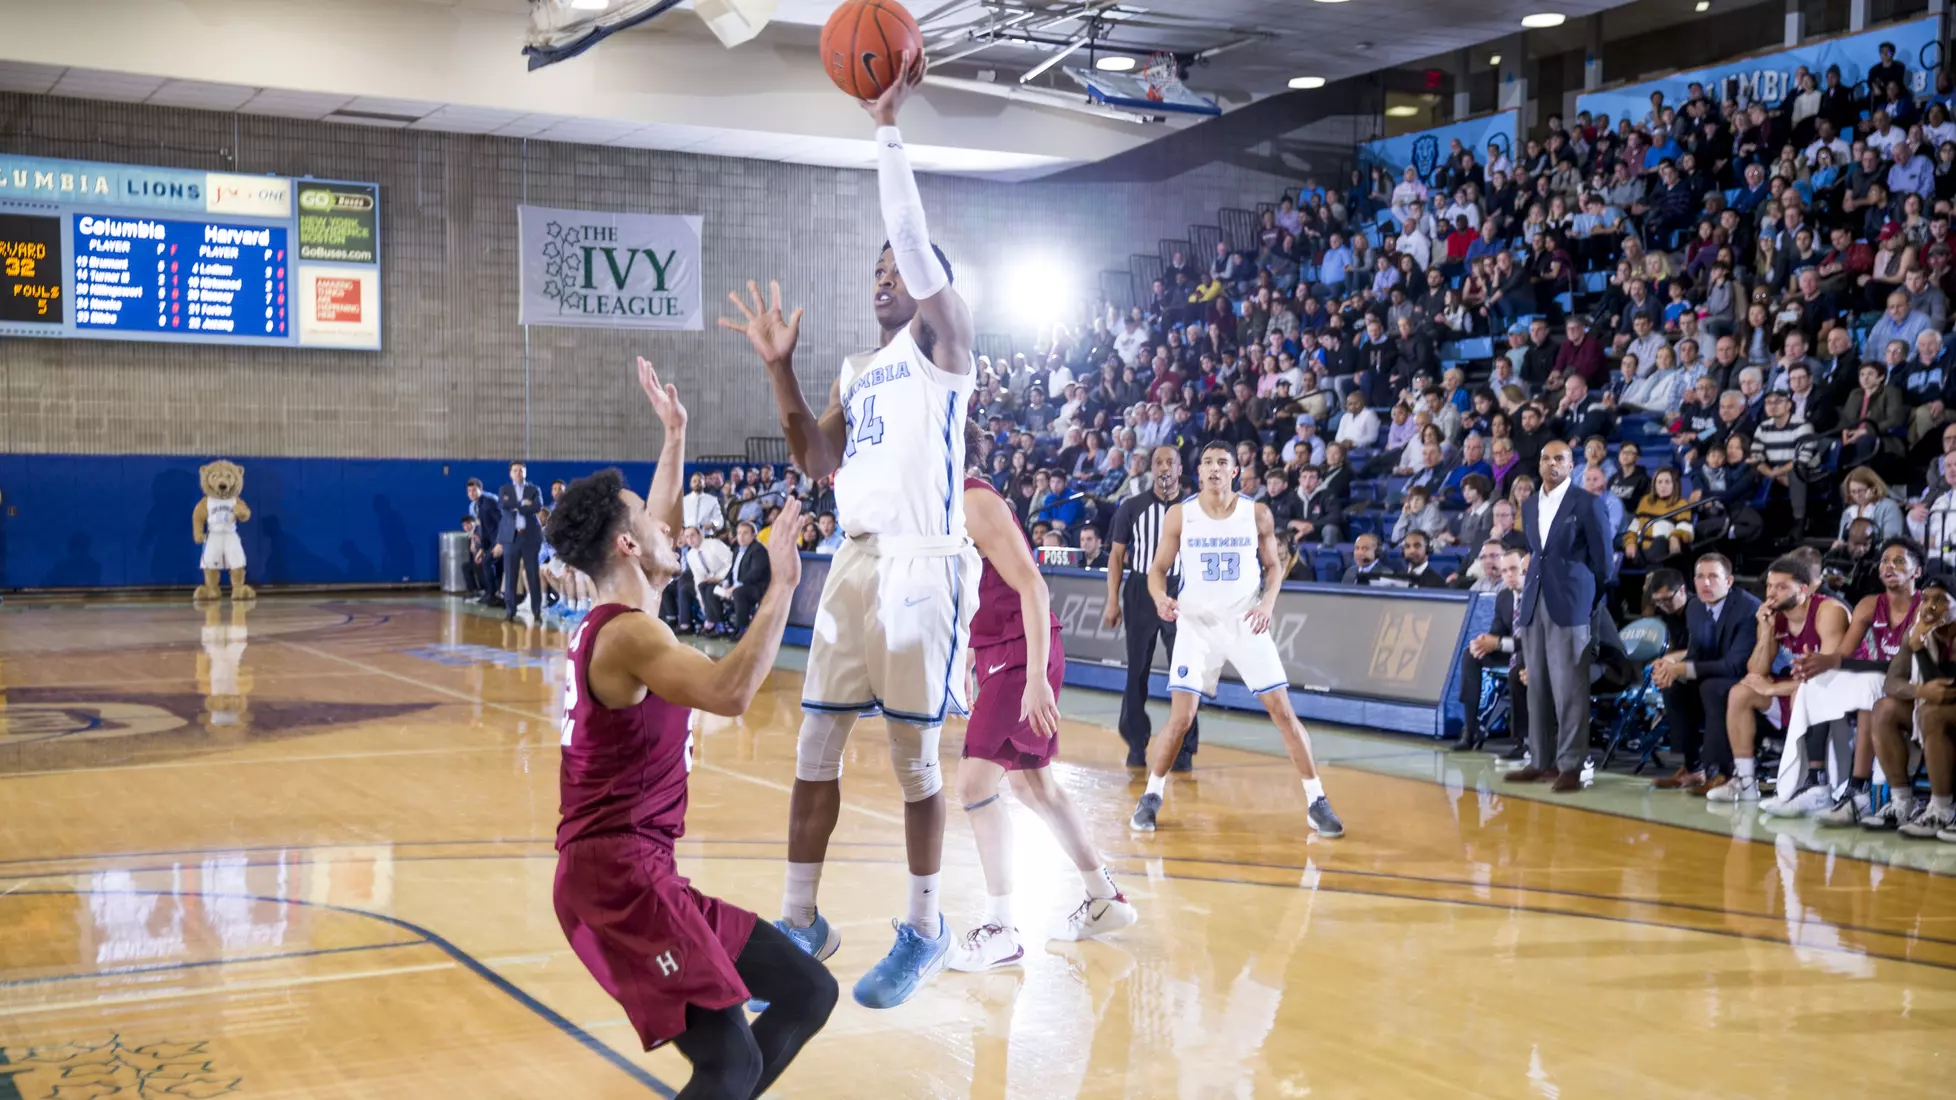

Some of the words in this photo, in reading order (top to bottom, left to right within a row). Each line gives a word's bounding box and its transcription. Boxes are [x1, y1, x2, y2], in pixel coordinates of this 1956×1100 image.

[127, 179, 201, 201] LIONS
[301, 191, 329, 206] GO
[79, 216, 166, 240] Columbia
[205, 224, 270, 247] Harvard
[580, 225, 618, 242] THE
[89, 238, 131, 253] PLAYER
[199, 244, 240, 260] PLAYER
[302, 245, 372, 261] GoBuses.com
[5, 257, 36, 278] 32
[579, 245, 677, 292] IVY
[13, 284, 60, 299] FOULS
[38, 299, 48, 315] 5
[582, 294, 679, 316] LEAGUE
[1186, 536, 1253, 549] COLUMBIA
[1043, 550, 1071, 566] POSS.
[1200, 552, 1241, 582] 33
[655, 948, 680, 977] H
